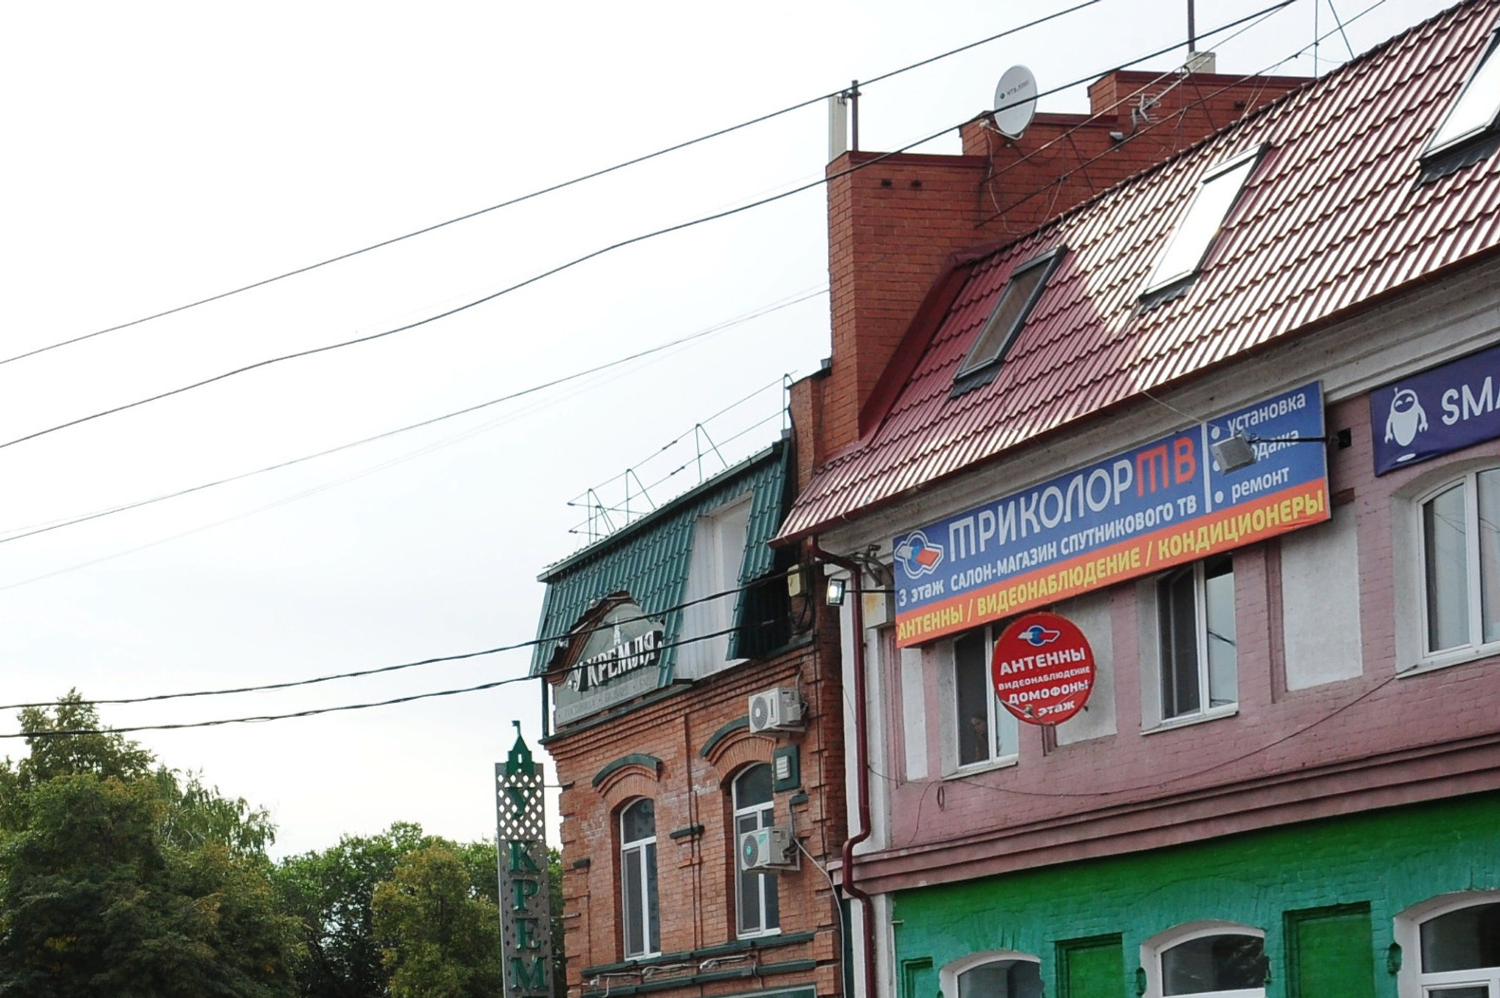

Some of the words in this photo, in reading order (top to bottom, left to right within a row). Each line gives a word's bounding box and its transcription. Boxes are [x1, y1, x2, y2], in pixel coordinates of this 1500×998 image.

[1227, 392, 1306, 438] установка
[1441, 375, 1500, 426] SM
[1231, 466, 1290, 504] ремонт
[897, 604, 964, 641] АНТЕННЫ
[976, 547, 1141, 617] ВИДЕОНАБЛЮДЕНИЕ
[1158, 489, 1324, 560] КОНДИЦИОНЕРЫ
[898, 588, 907, 607] 3
[910, 578, 945, 604] этаж
[950, 541, 1057, 592] САЛОН-МАГАЗИН
[1060, 502, 1174, 555] СПУТНИКОВОГО
[1177, 494, 1197, 517] ТВ
[586, 630, 656, 687] КРЕМЛЯ
[998, 665, 1091, 691] ВИДЕОНАБЛЮДЕНИЕ
[1000, 647, 1086, 676] АНТЕННЫ
[1008, 679, 1089, 705] ДОМОФОНЫ
[1038, 700, 1076, 717] этаж
